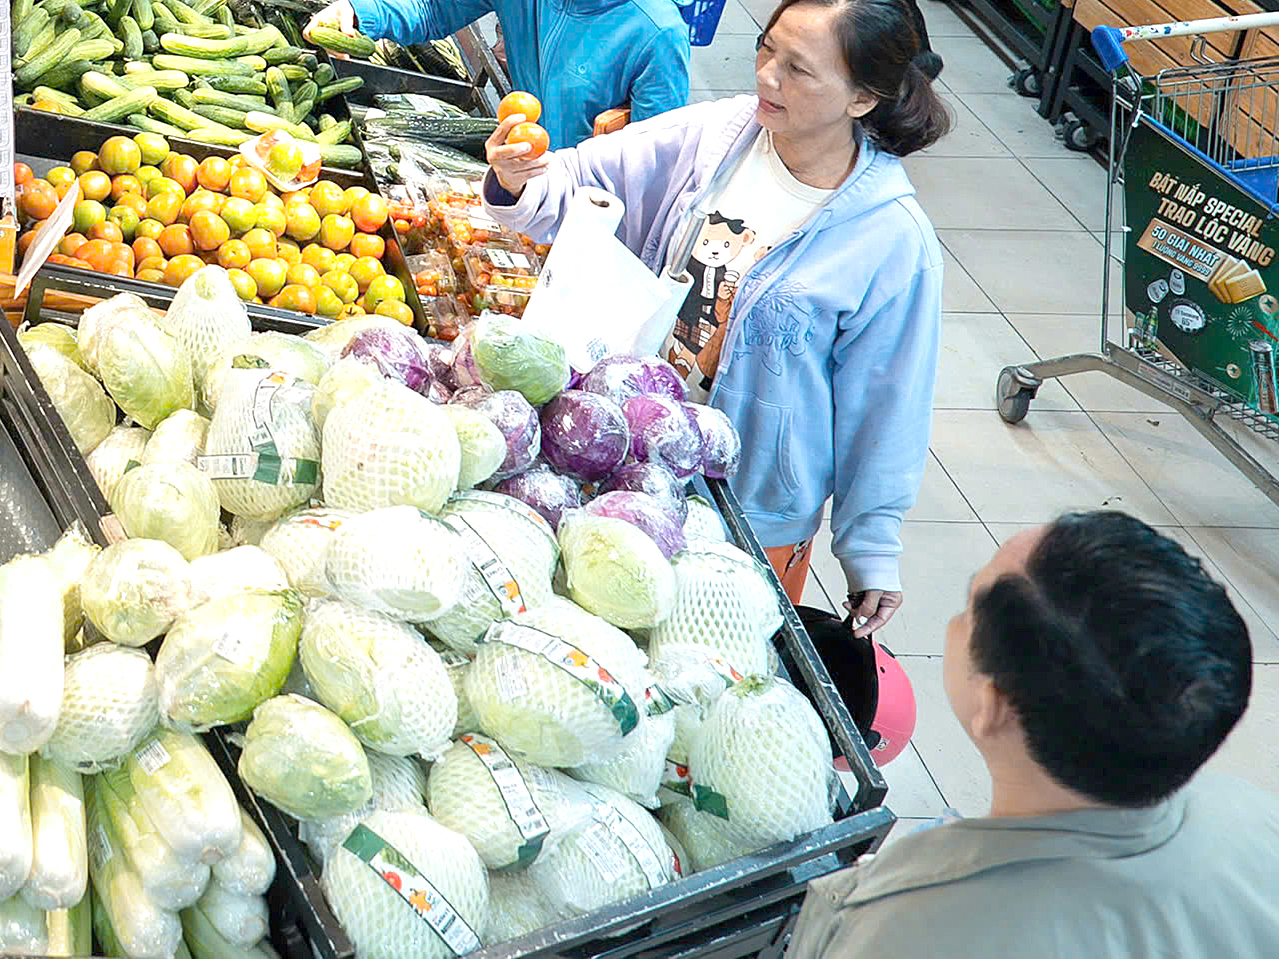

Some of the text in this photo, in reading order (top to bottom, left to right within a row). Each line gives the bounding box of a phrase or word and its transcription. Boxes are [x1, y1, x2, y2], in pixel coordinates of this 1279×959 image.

[1149, 171, 1264, 238] BẬT NẮP SPECIAL
[1157, 197, 1276, 268] TRAO LỘC VÀNG
[1151, 226, 1220, 268] 50 GIẢI NHẤT
